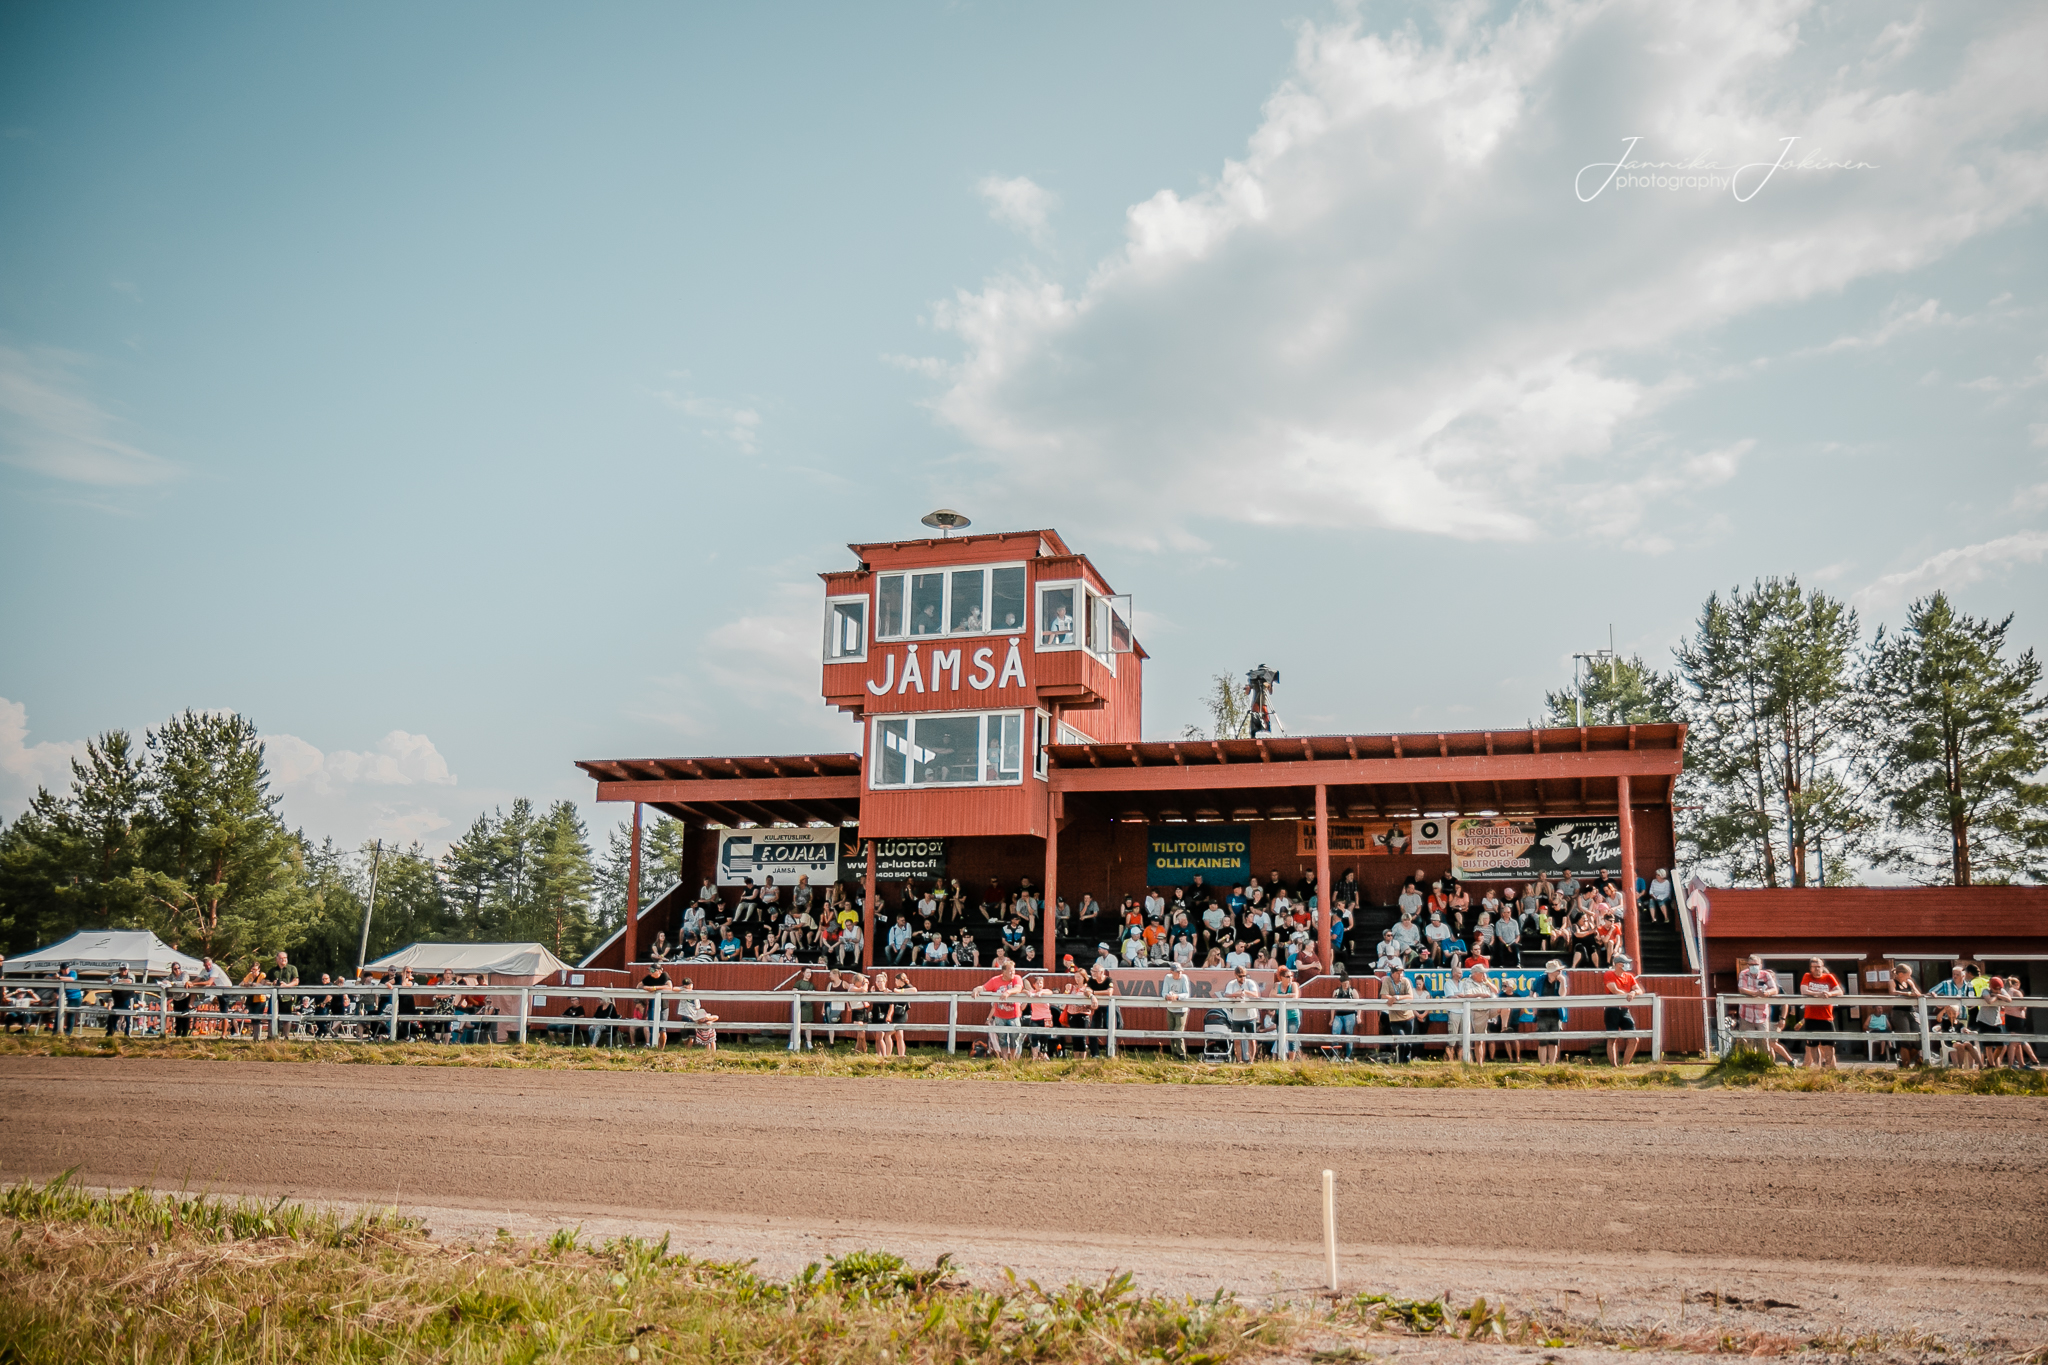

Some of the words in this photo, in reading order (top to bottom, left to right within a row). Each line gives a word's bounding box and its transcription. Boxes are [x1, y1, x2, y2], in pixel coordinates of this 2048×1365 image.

[1469, 825, 1521, 836] ROUHEITA
[1457, 835, 1535, 846] BISTRORUOKIA!
[1570, 826, 1619, 850] Hilpeä
[928, 841, 943, 852] OY
[1152, 842, 1246, 853] TILITOIMISTO
[1477, 849, 1514, 858] ROUGH
[1586, 846, 1621, 864] Hirv
[846, 858, 937, 869] ww.a-luoto.fi
[1156, 857, 1241, 869] OLLIKAINEN
[1462, 858, 1530, 868] BISTROFOOD!
[1116, 980, 1212, 998] VIAR
